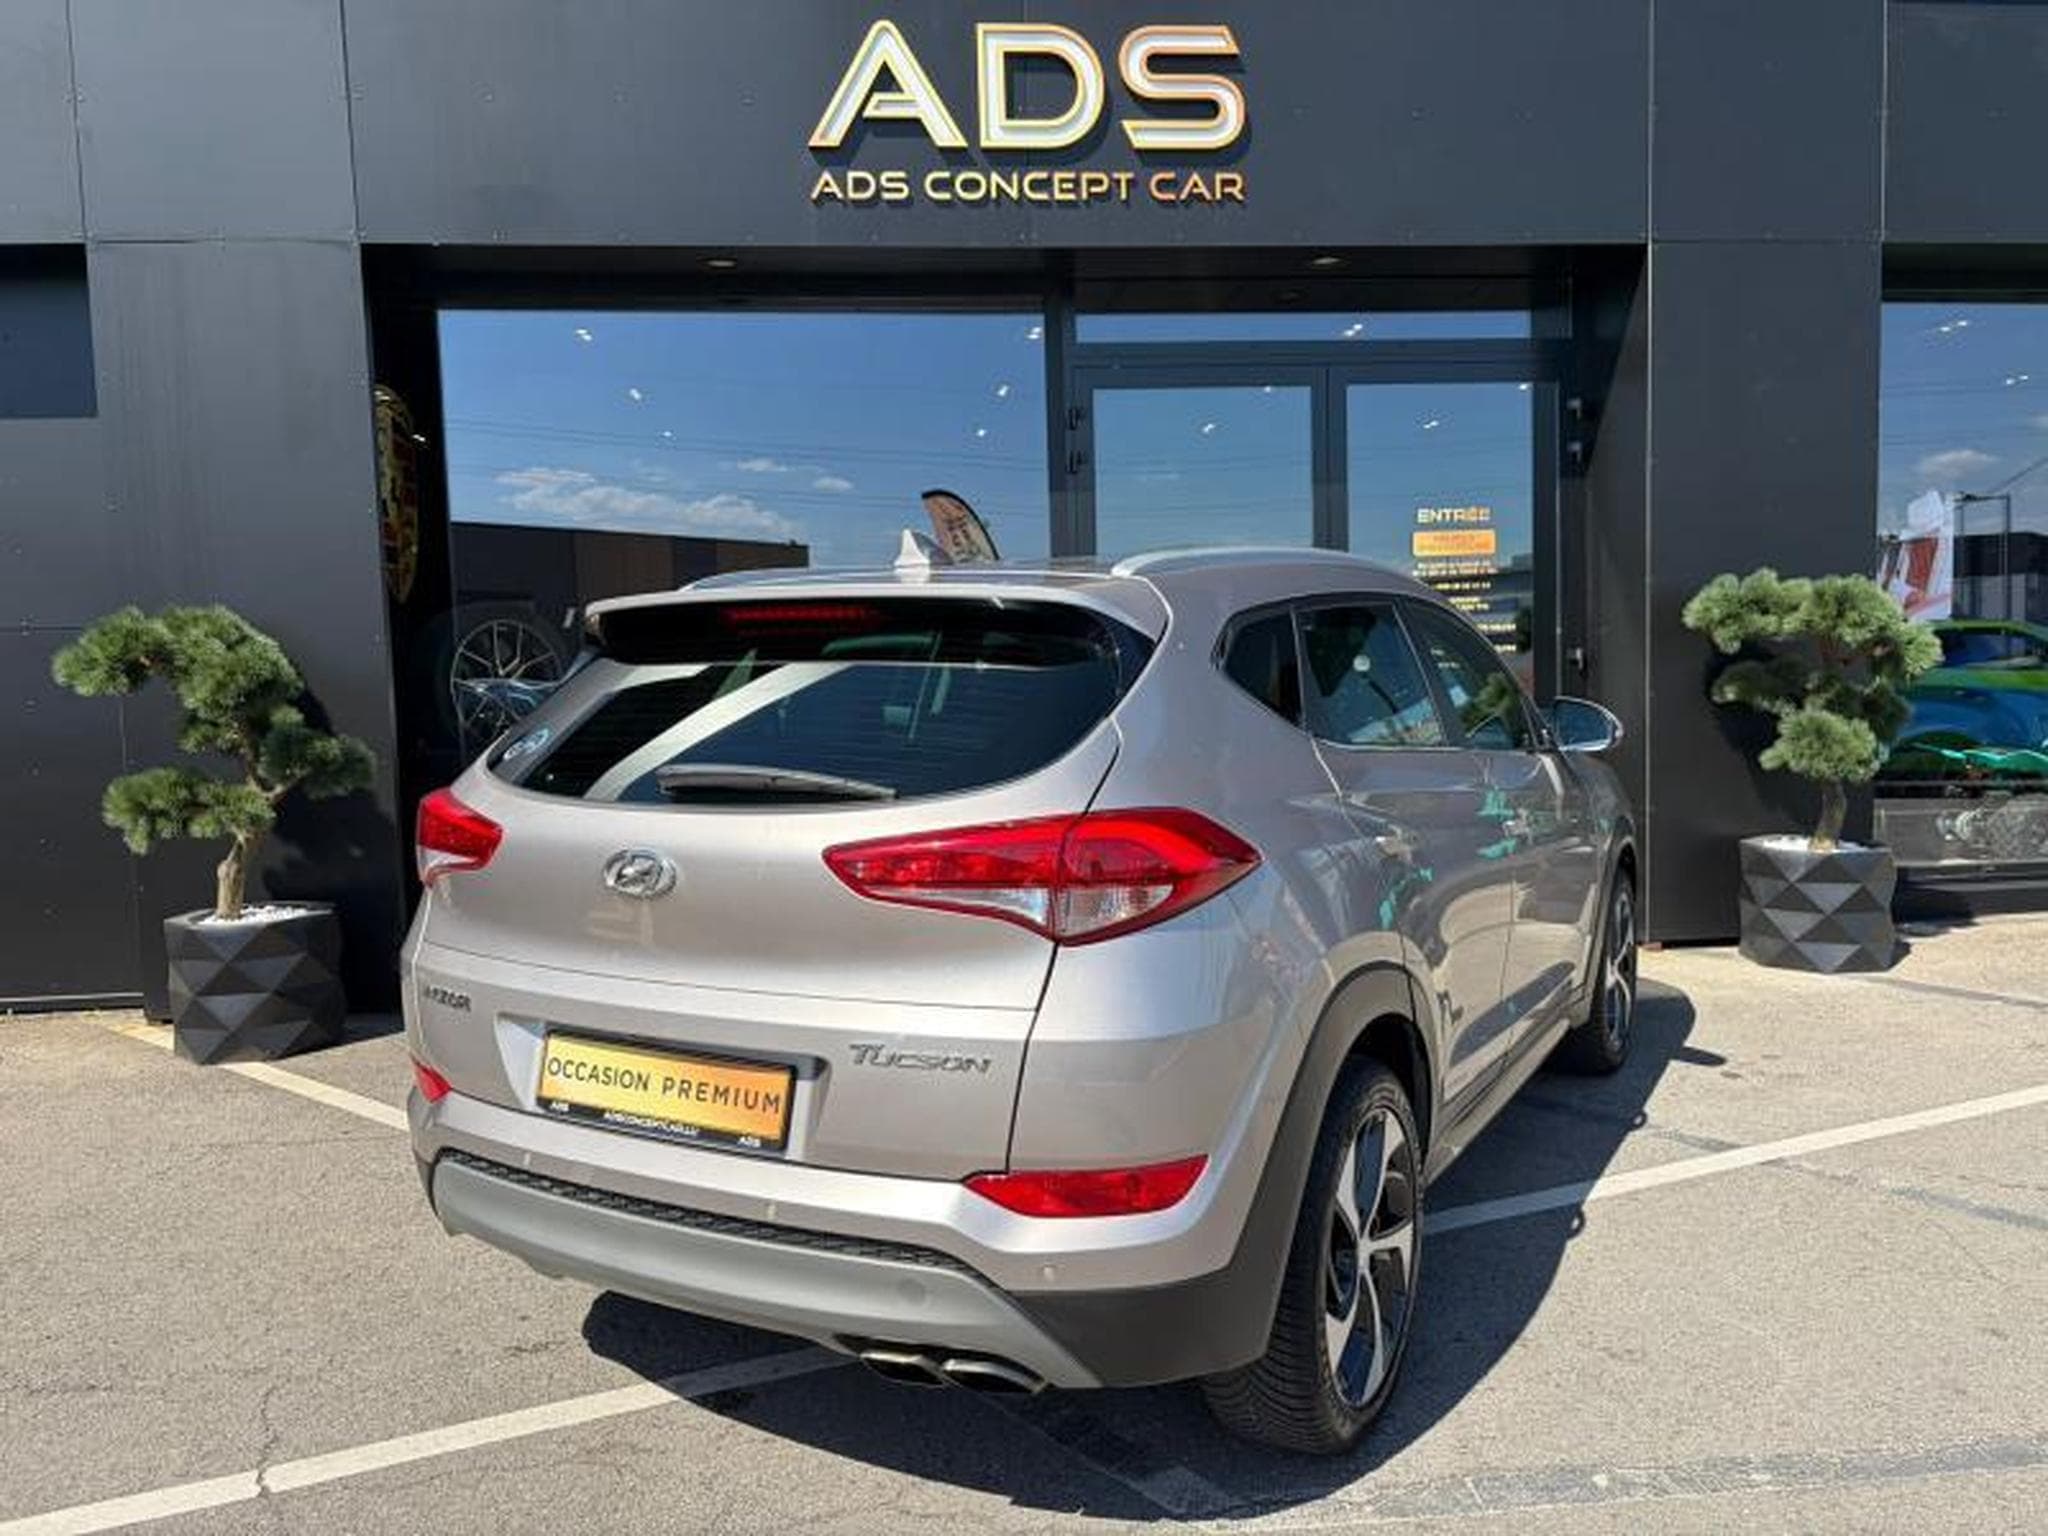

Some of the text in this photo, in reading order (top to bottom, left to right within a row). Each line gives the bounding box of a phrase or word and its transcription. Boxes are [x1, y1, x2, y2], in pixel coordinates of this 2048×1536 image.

[808, 19, 1246, 150] ADS
[811, 171, 1244, 200] ADS CONCEPT CAR
[848, 1044, 991, 1074] TUCSON
[547, 1056, 781, 1115] OCCASION PREMIUM
